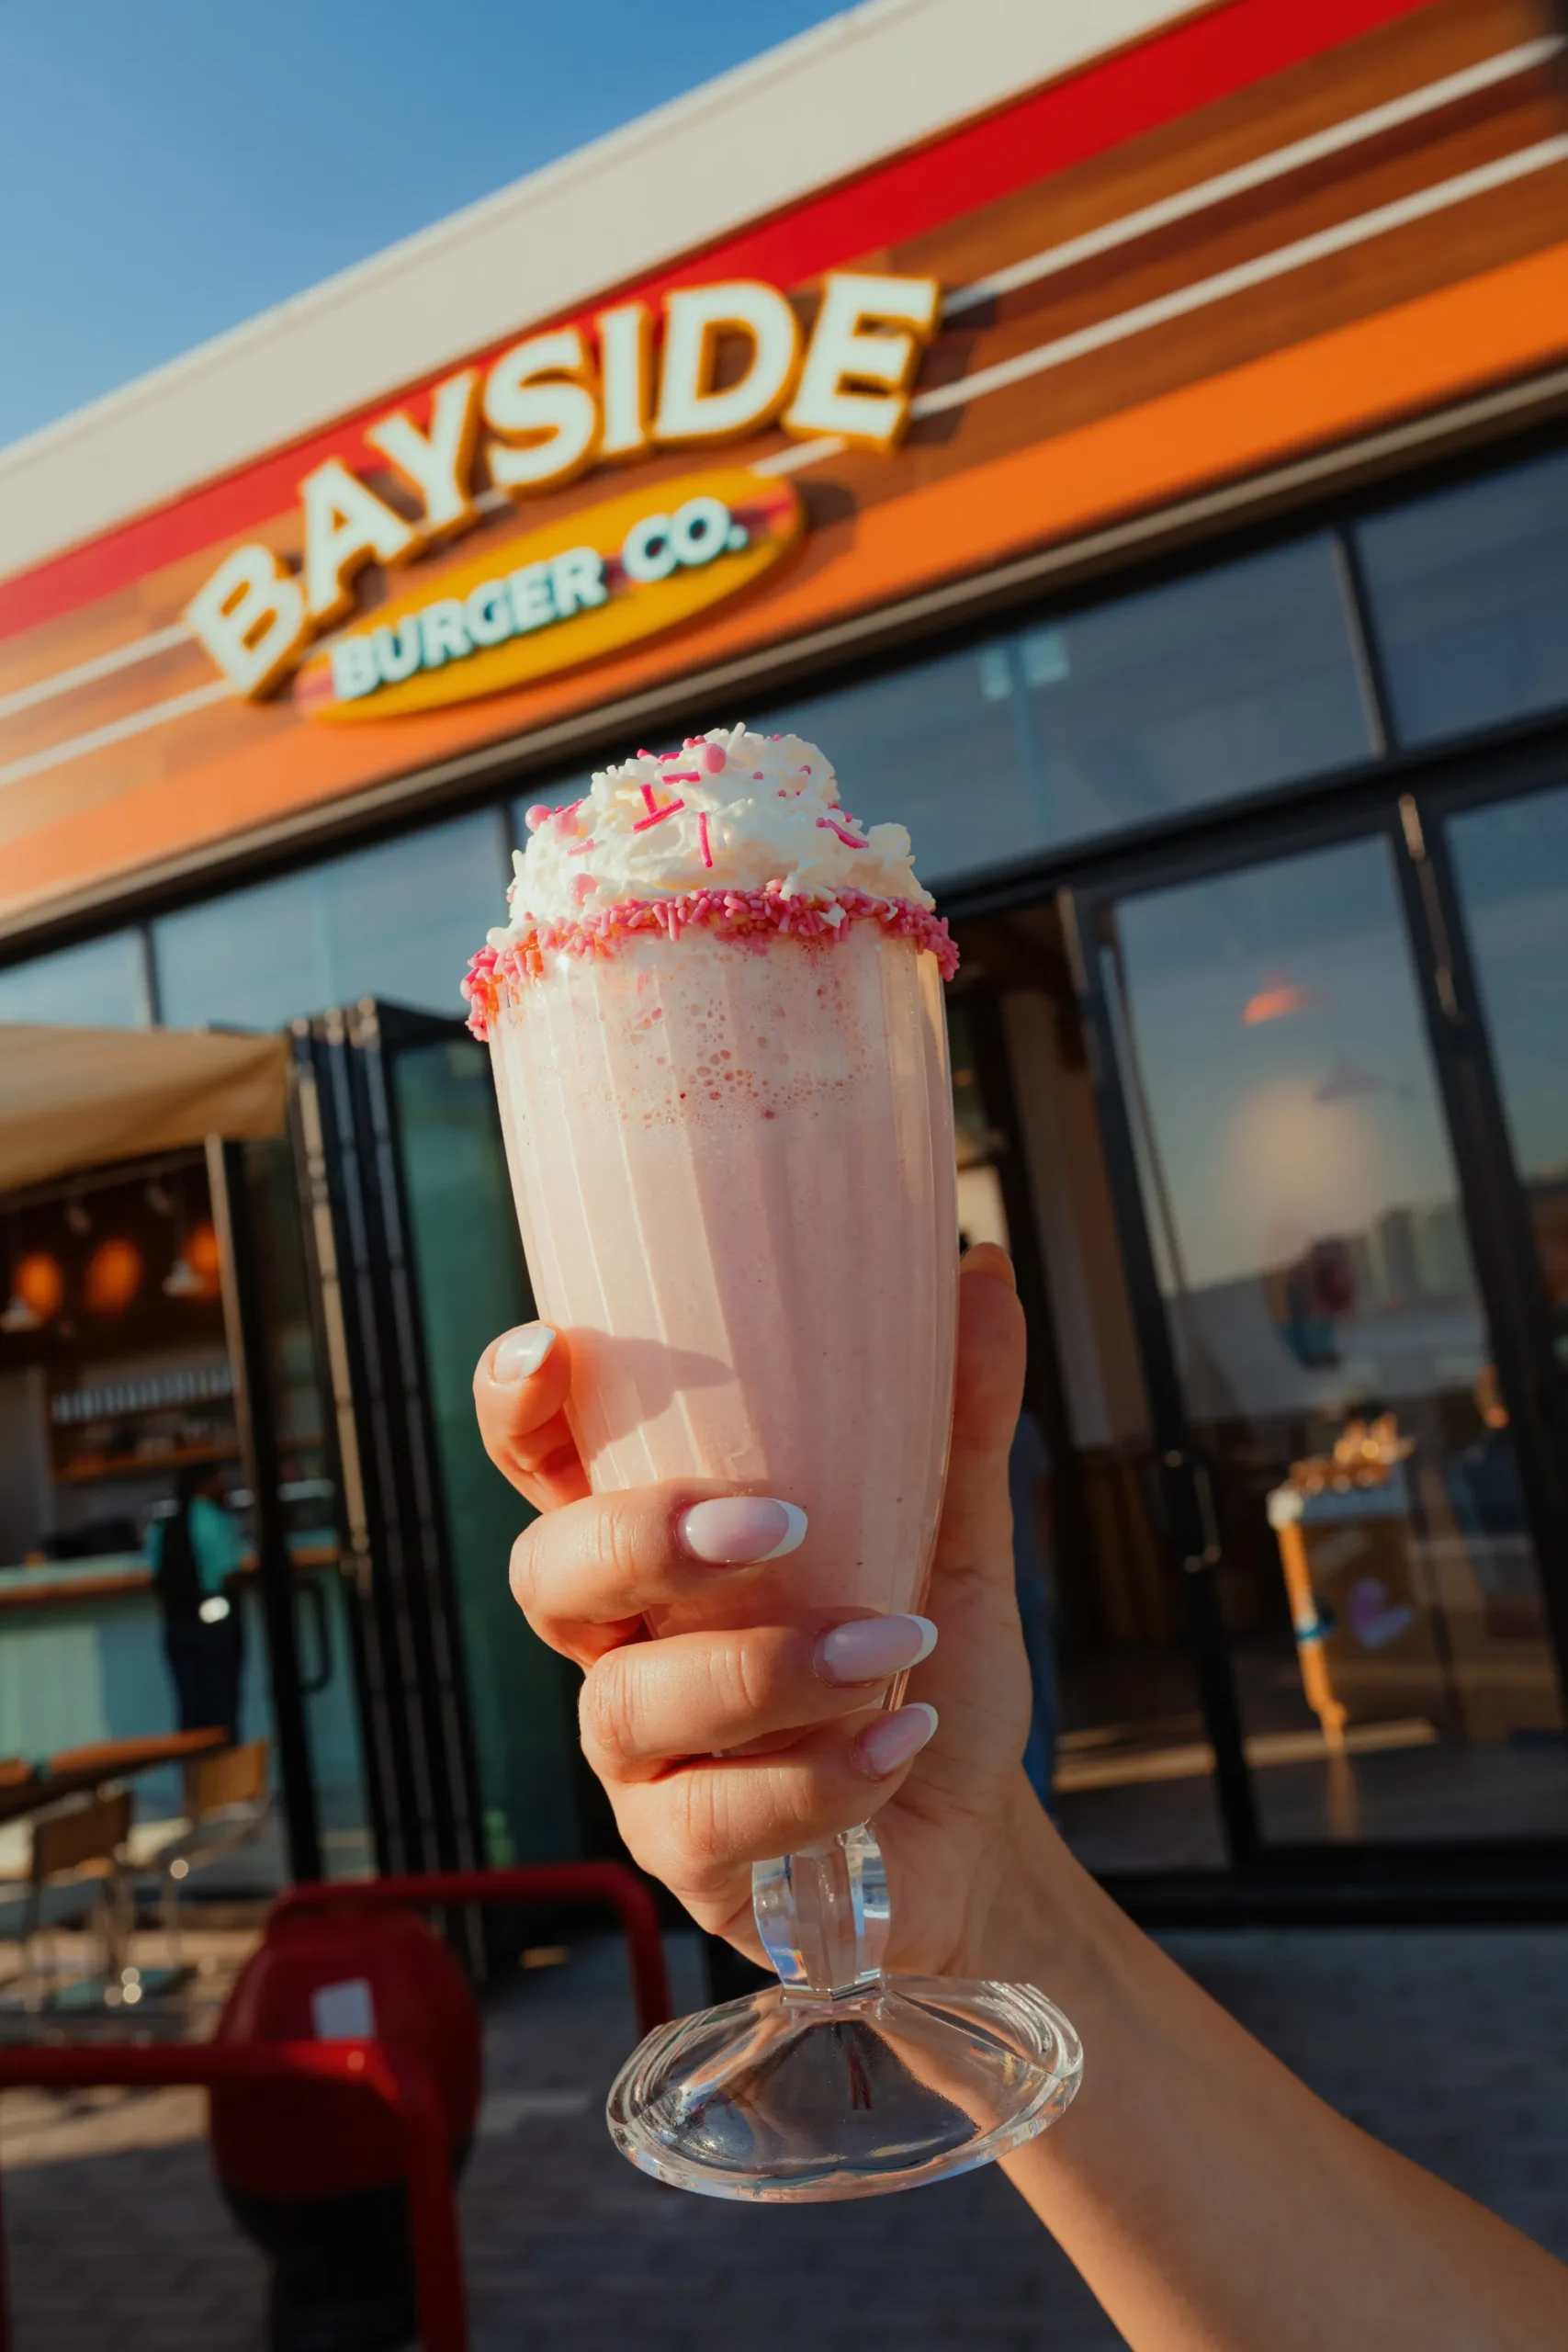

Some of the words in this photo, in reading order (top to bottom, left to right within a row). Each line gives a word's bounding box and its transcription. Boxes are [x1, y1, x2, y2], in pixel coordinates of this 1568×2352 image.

[186, 272, 939, 697] BAYSIDE
[333, 546, 607, 699] BURGER
[623, 497, 749, 582] CO.
